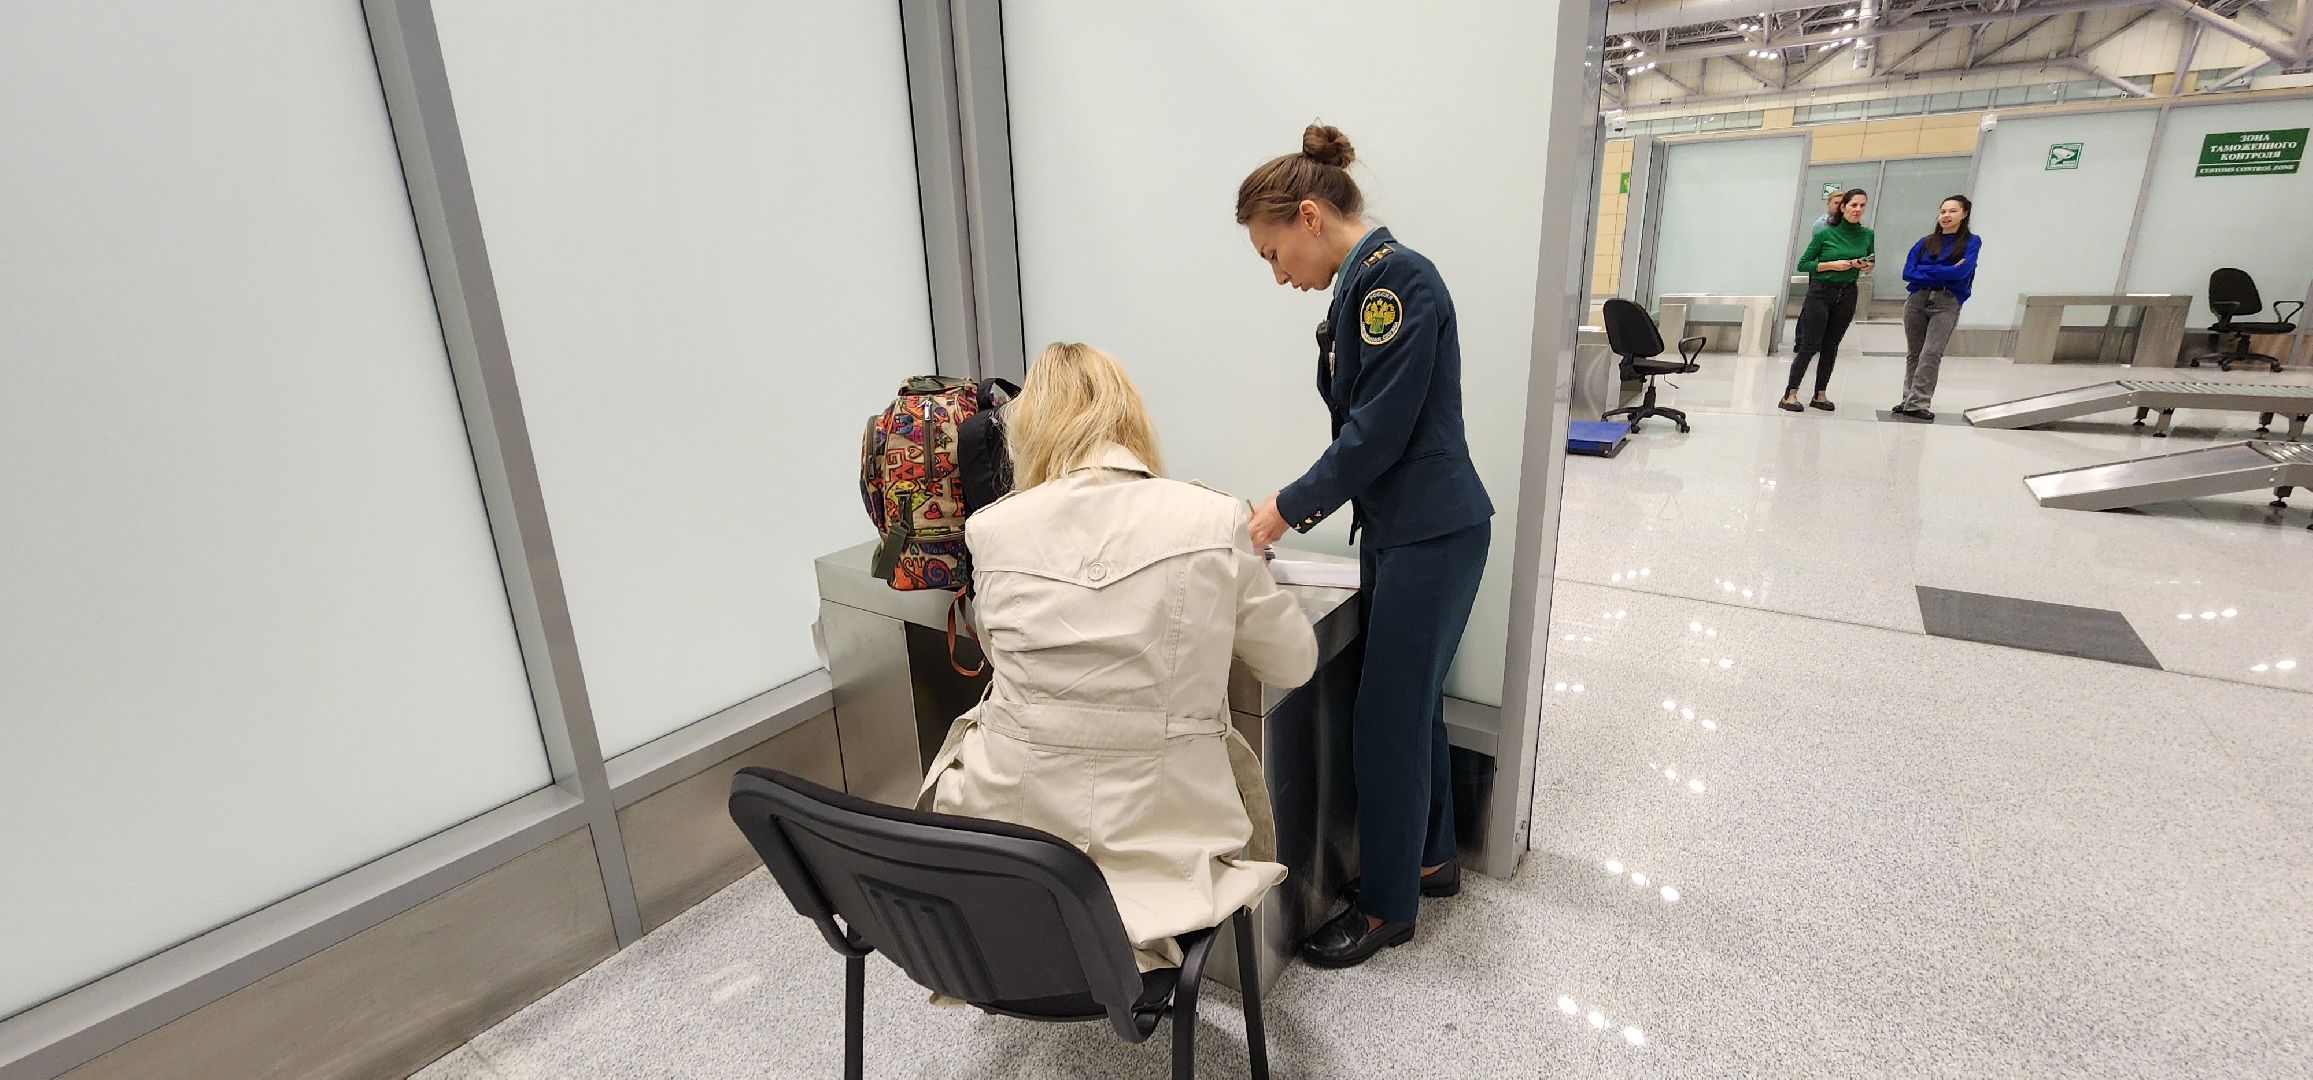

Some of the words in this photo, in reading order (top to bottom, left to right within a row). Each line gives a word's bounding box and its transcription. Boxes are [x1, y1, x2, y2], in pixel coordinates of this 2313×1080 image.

[2239, 134, 2270, 142] ЗОНА
[2210, 141, 2297, 152] ТАМОЖЕННОГО
[2220, 151, 2281, 160] КОНТРОЛЯ
